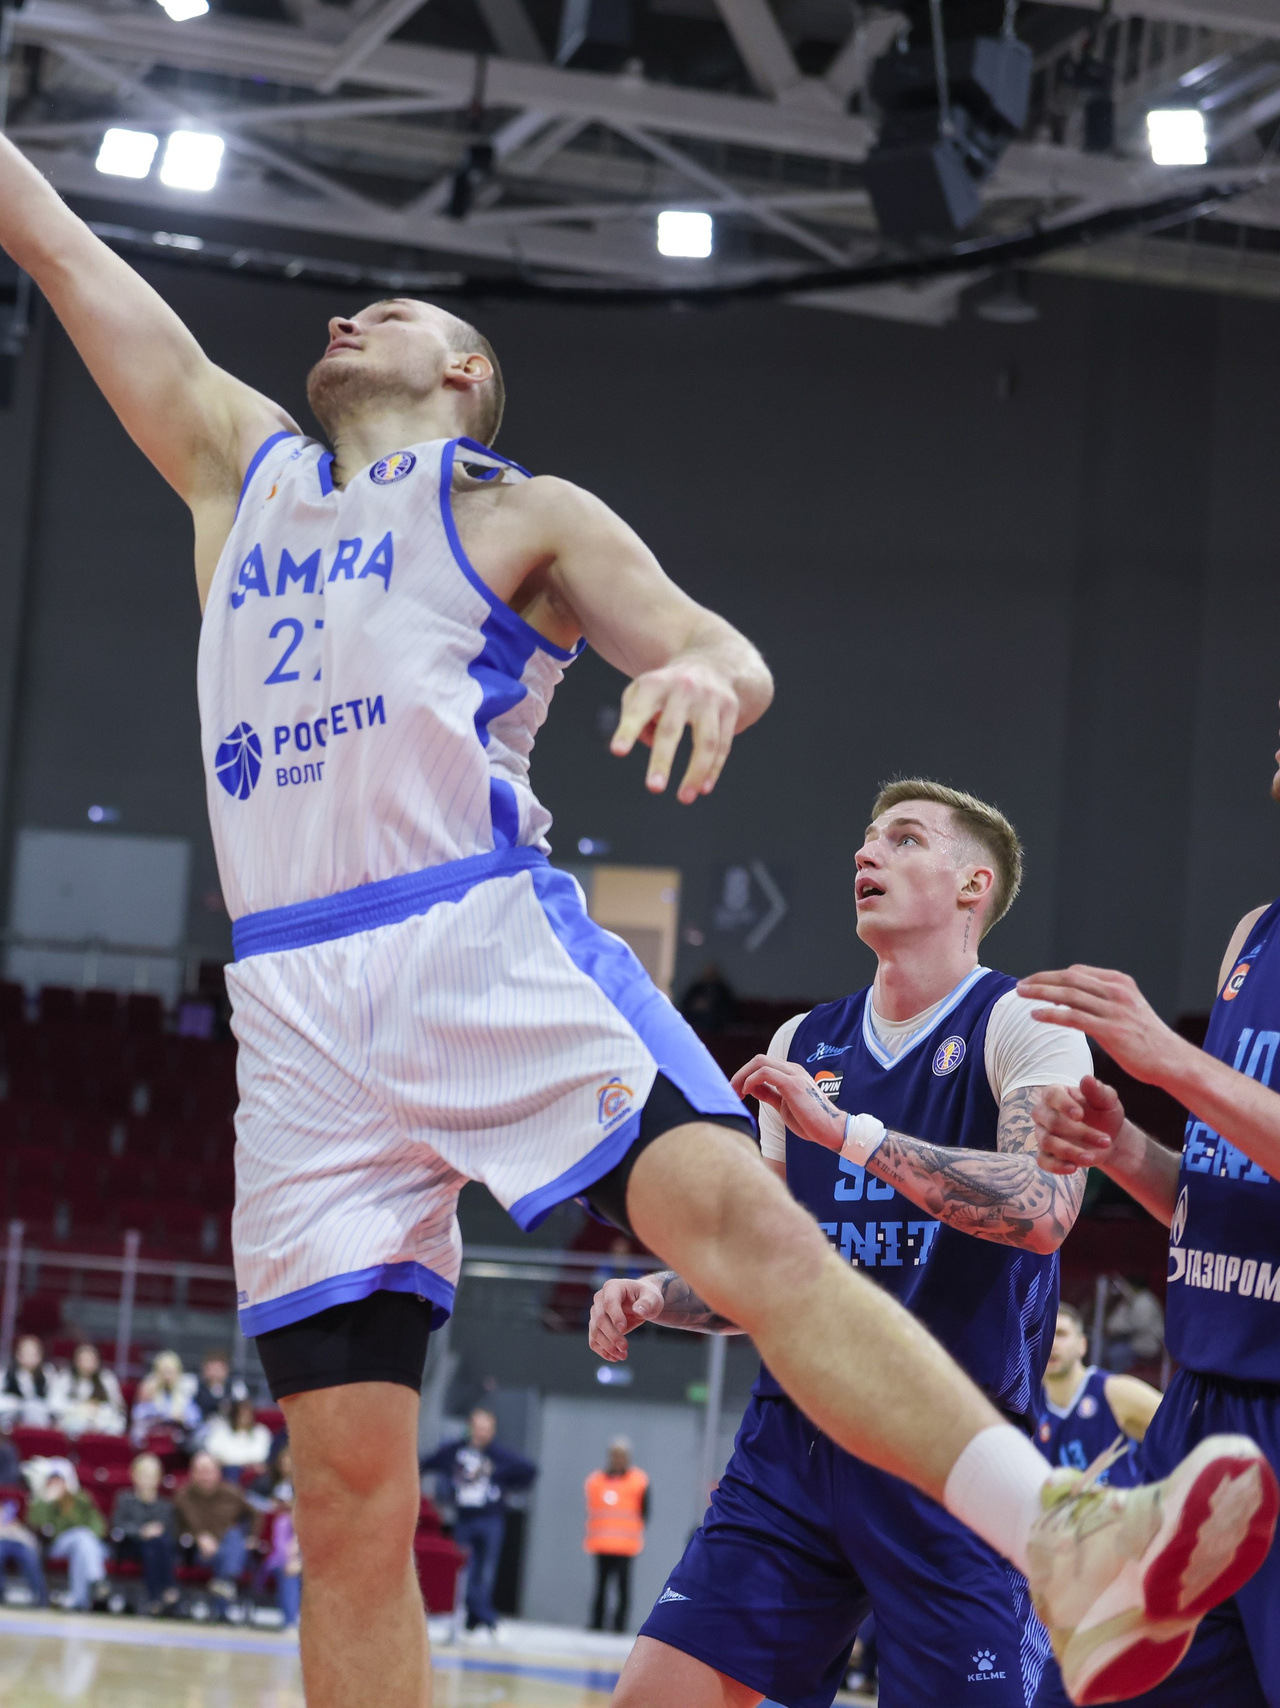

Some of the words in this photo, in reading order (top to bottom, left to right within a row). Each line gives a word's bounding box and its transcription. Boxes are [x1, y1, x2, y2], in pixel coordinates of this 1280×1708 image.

[821, 1081, 842, 1092] WIN
[1184, 1248, 1280, 1304] ГАЗПРОМ
[967, 1671, 1007, 1682] KELME
